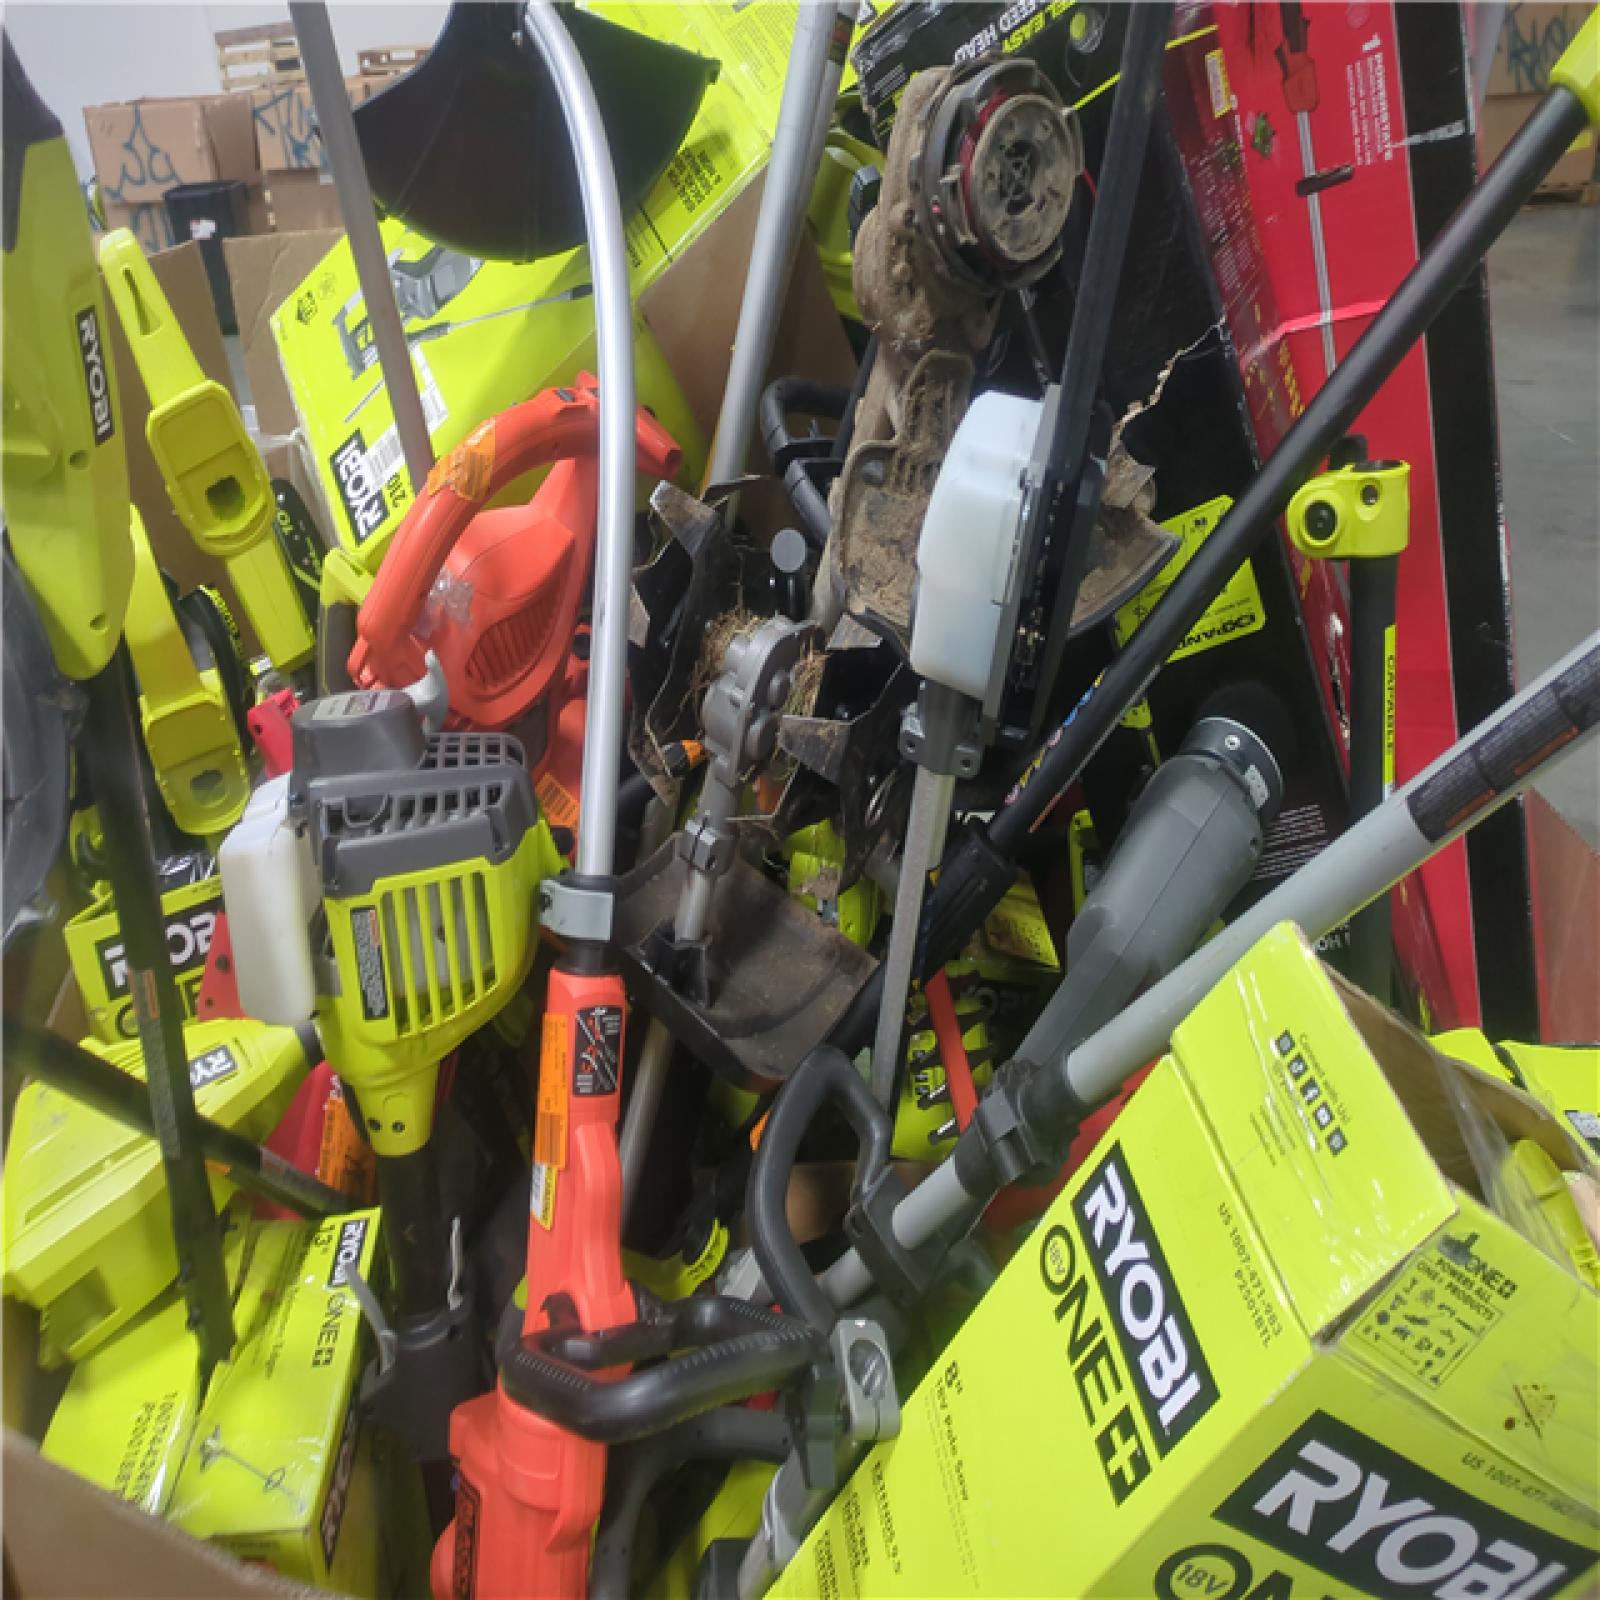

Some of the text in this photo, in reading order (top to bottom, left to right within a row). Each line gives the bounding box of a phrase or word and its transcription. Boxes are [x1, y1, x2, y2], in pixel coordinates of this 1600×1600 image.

[78, 316, 112, 437] RYOBI
[335, 439, 384, 537] RYOBI
[1386, 654, 1395, 754] CAPABLE
[1083, 1162, 1201, 1428] RYOBI
[1040, 1225, 1152, 1508] ONE+
[1177, 1564, 1230, 1595] 18V
[1252, 1440, 1568, 1600] RYOBI
